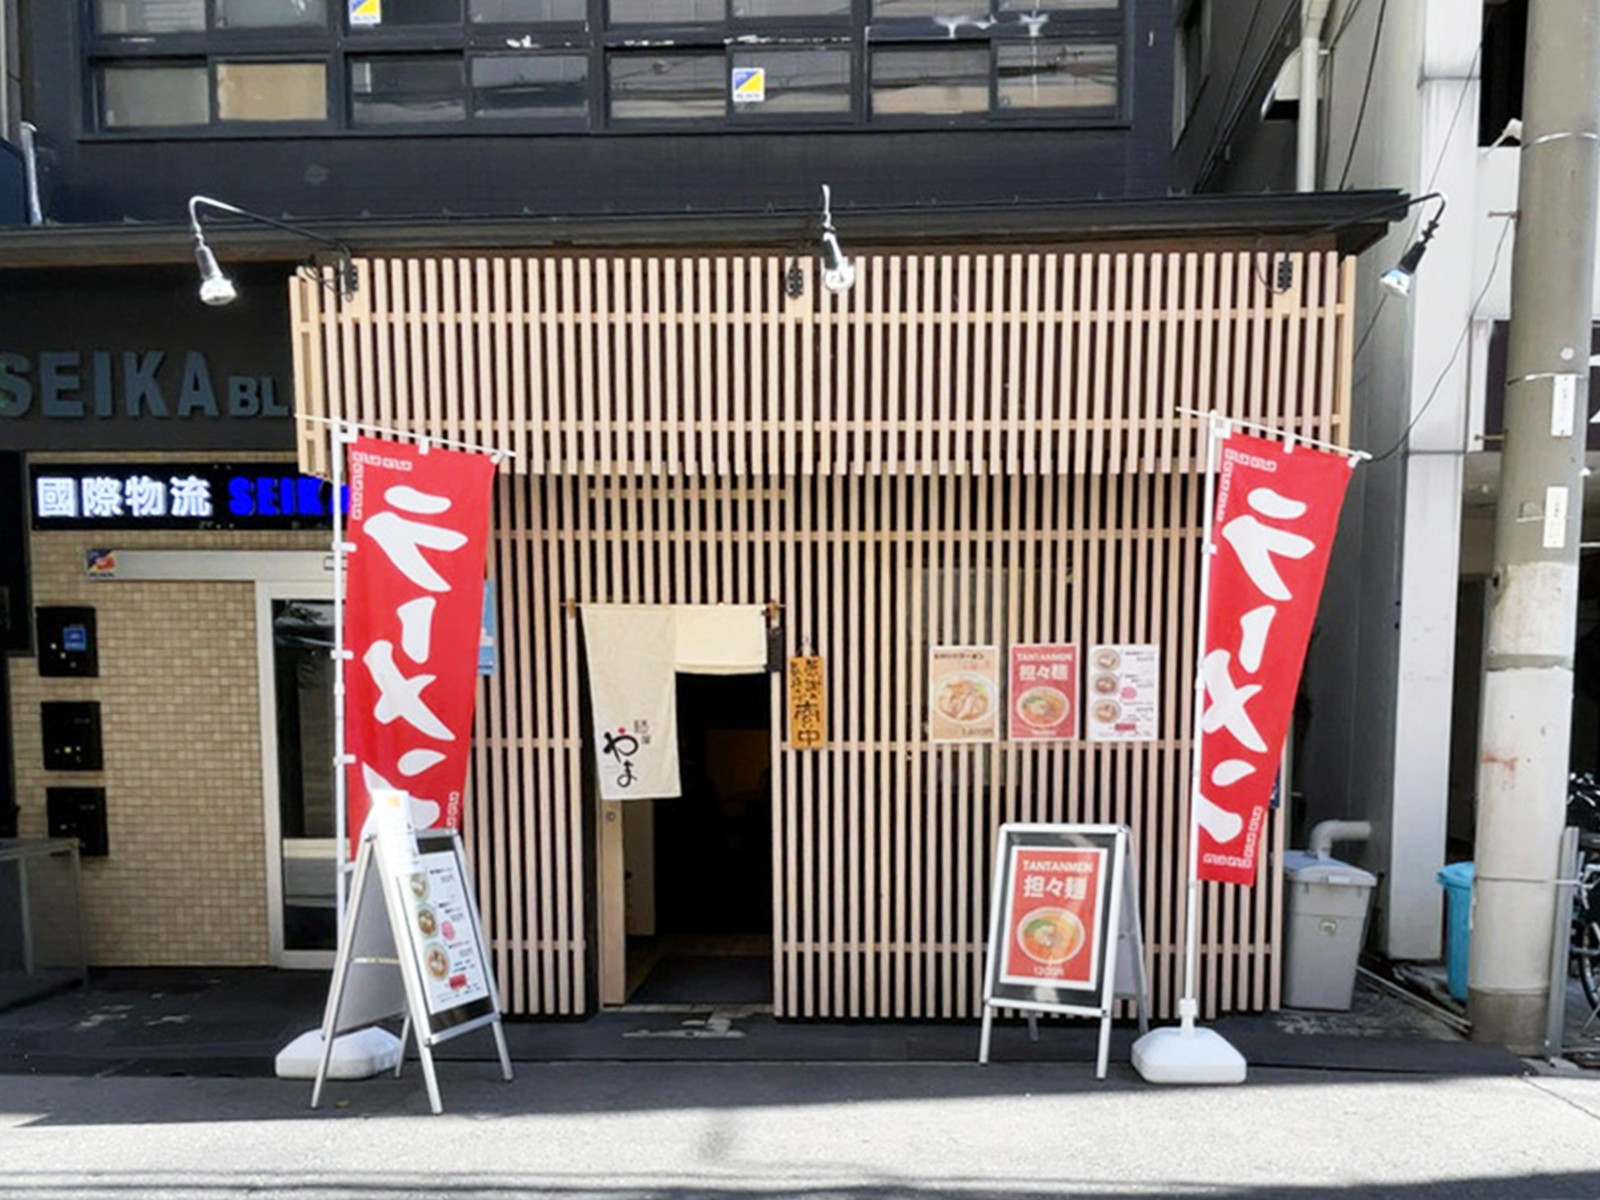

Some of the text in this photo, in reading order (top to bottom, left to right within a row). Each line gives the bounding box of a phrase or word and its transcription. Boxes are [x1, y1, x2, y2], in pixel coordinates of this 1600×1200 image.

[0, 350, 219, 418] SEIKA
[36, 476, 213, 518] 國際物流
[363, 485, 469, 831] ラーメン
[1197, 487, 1316, 845] ラーメン
[1022, 860, 1094, 873] TANTANMEN
